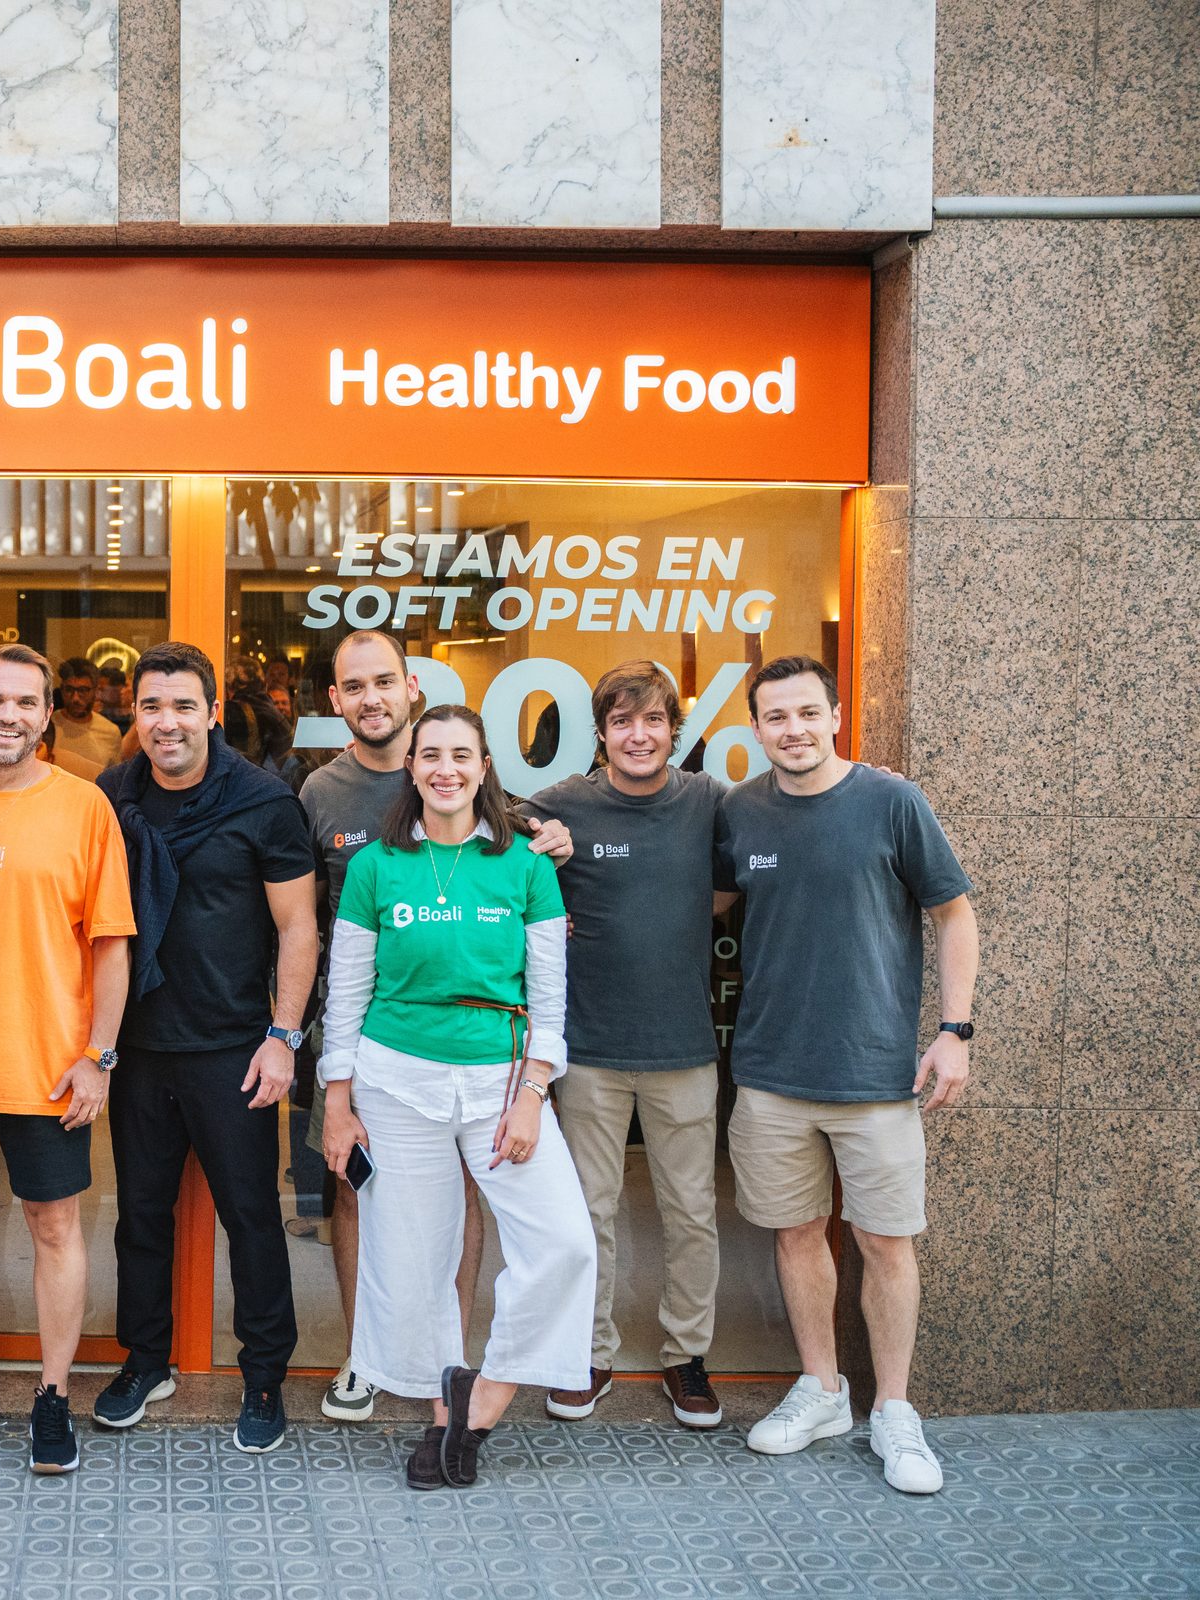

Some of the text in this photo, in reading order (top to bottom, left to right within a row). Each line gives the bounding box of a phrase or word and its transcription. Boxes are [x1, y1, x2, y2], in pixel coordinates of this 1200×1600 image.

[2, 315, 796, 424] Boali Healthy Food
[337, 533, 744, 581] ESTAMOS EN
[302, 584, 777, 633] SOFT OPENING
[344, 829, 367, 842] Boali
[605, 843, 629, 854] Boali
[757, 853, 777, 865] Boali
[418, 905, 462, 922] Boali
[477, 906, 511, 917] Healthy
[477, 914, 500, 923] Food
